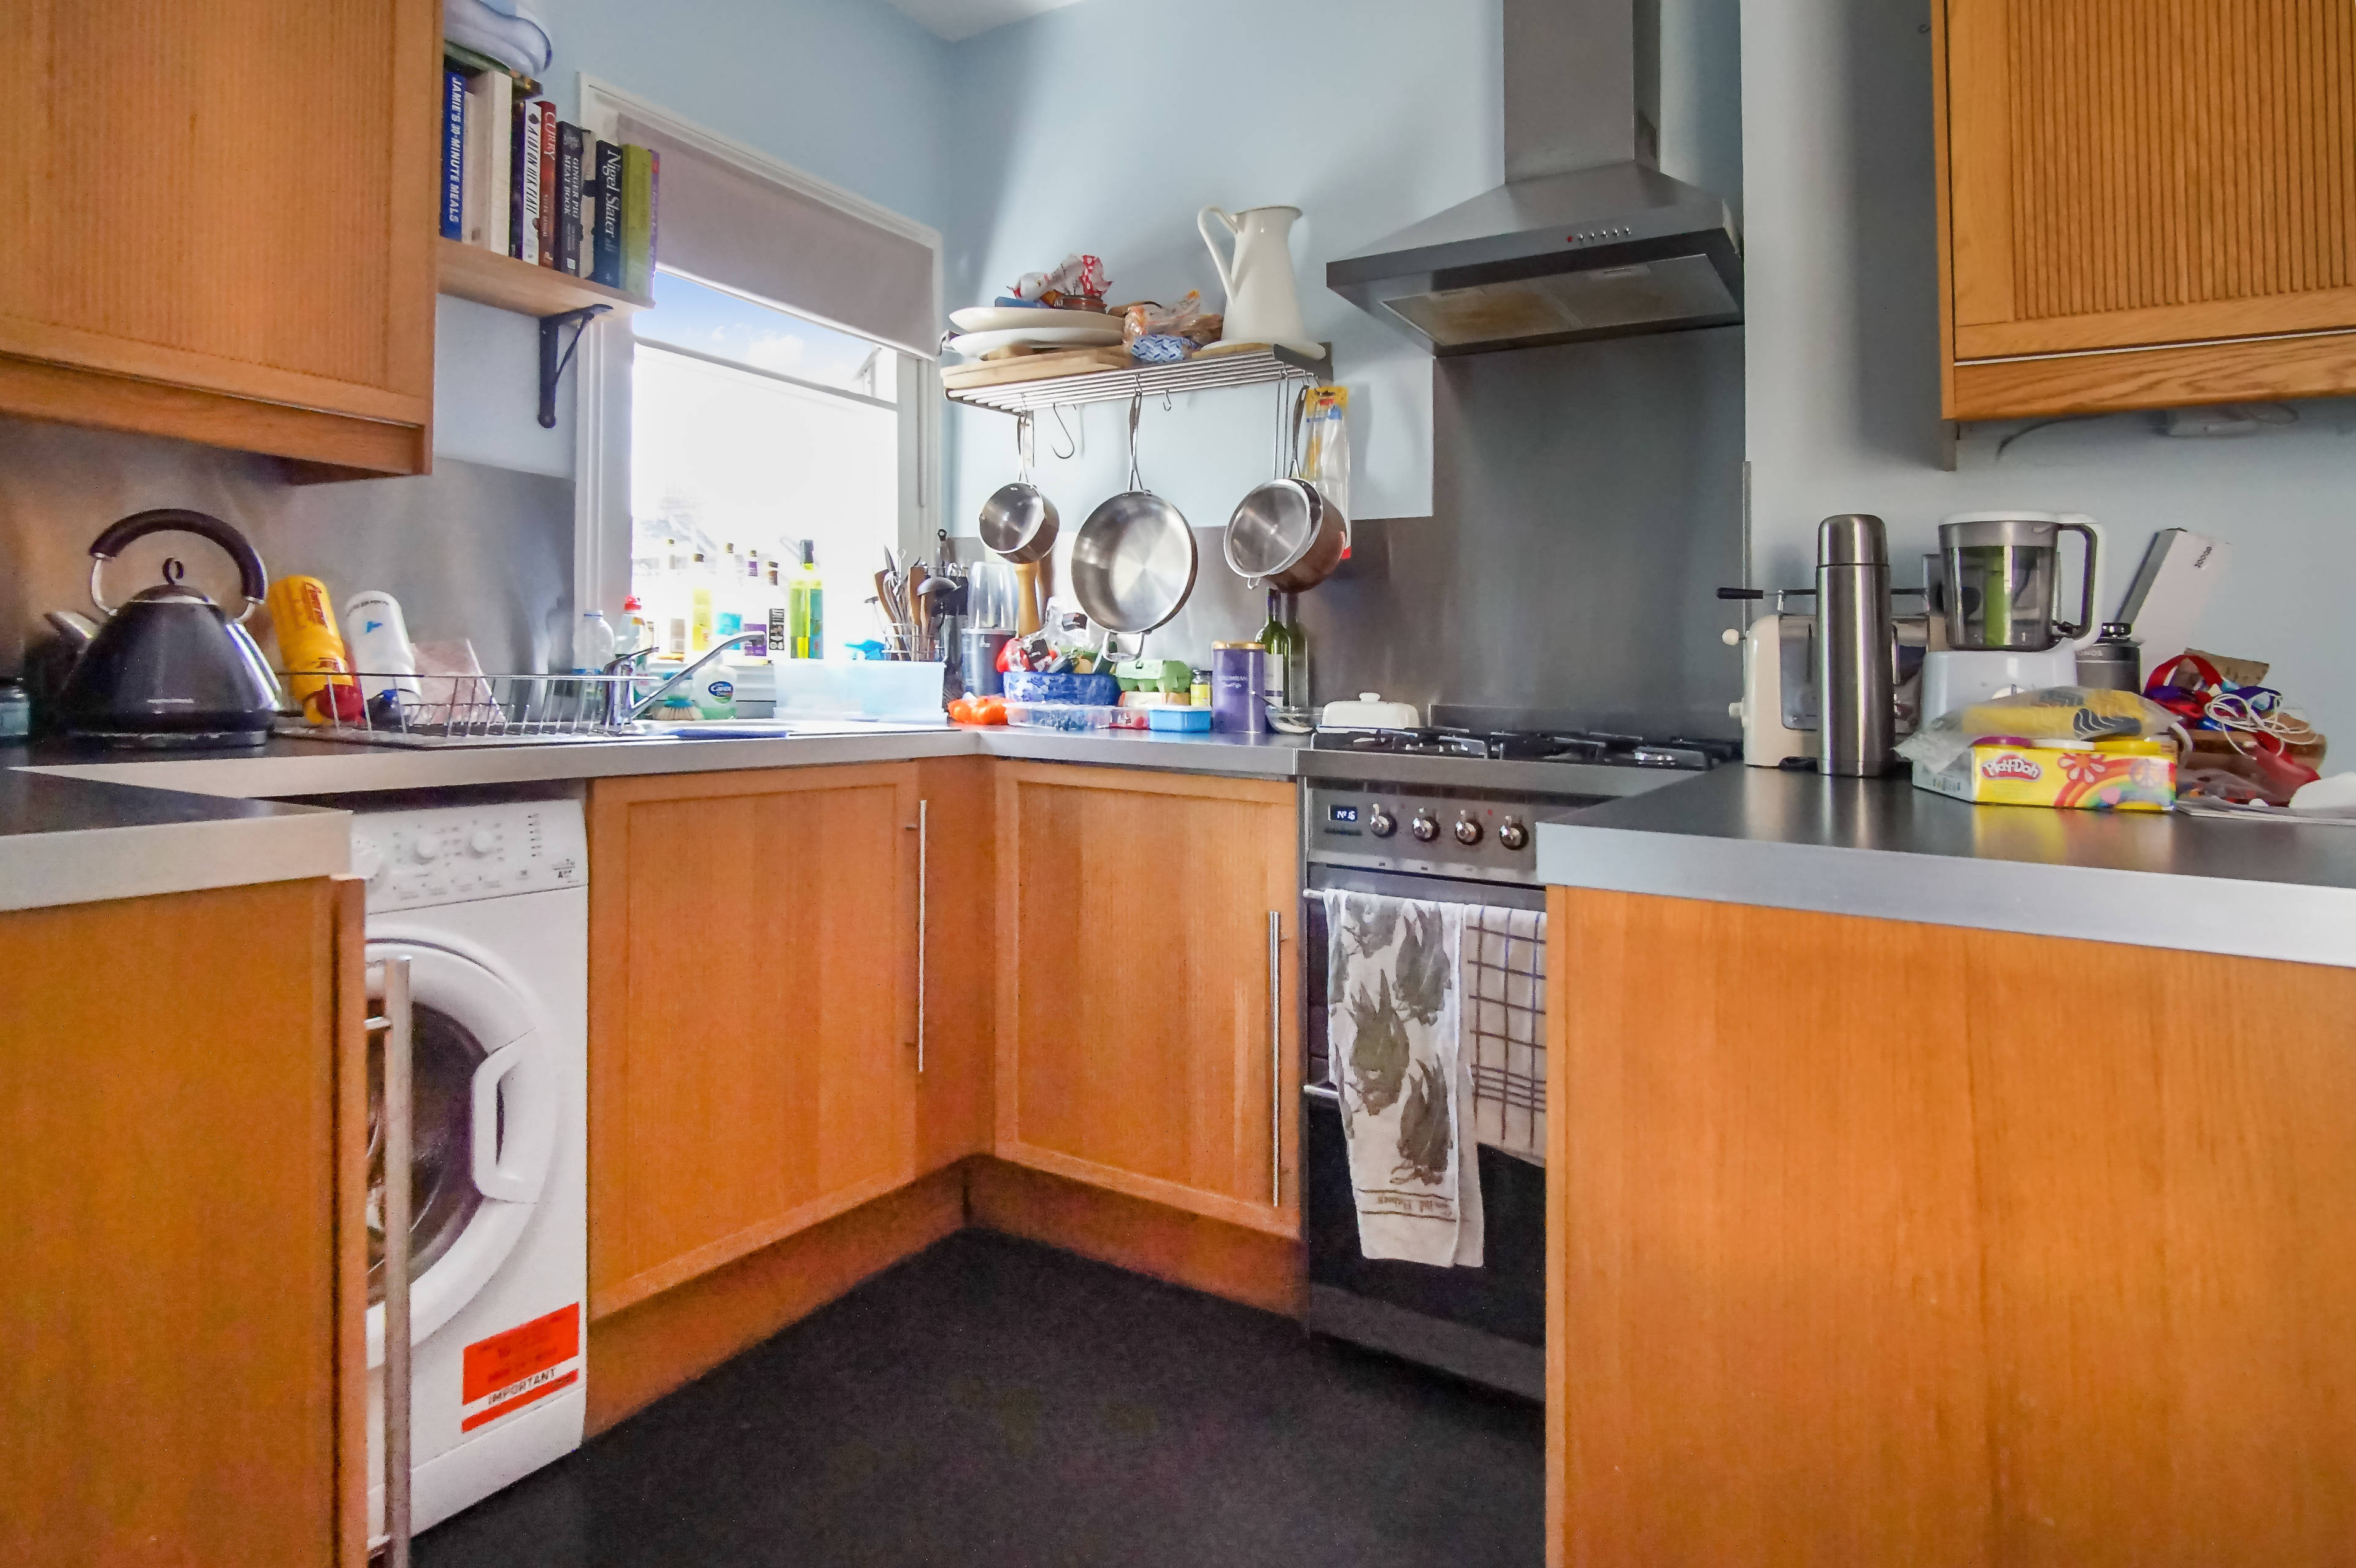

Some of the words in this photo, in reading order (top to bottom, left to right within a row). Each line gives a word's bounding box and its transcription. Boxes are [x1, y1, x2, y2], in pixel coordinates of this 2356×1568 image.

[451, 77, 463, 122] JAMIE'S
[544, 111, 556, 161] CURRY
[602, 149, 622, 192] Nigel
[449, 182, 460, 223] MEALS
[604, 193, 620, 239] Slater
[488, 1368, 556, 1405] IMPORTANT
